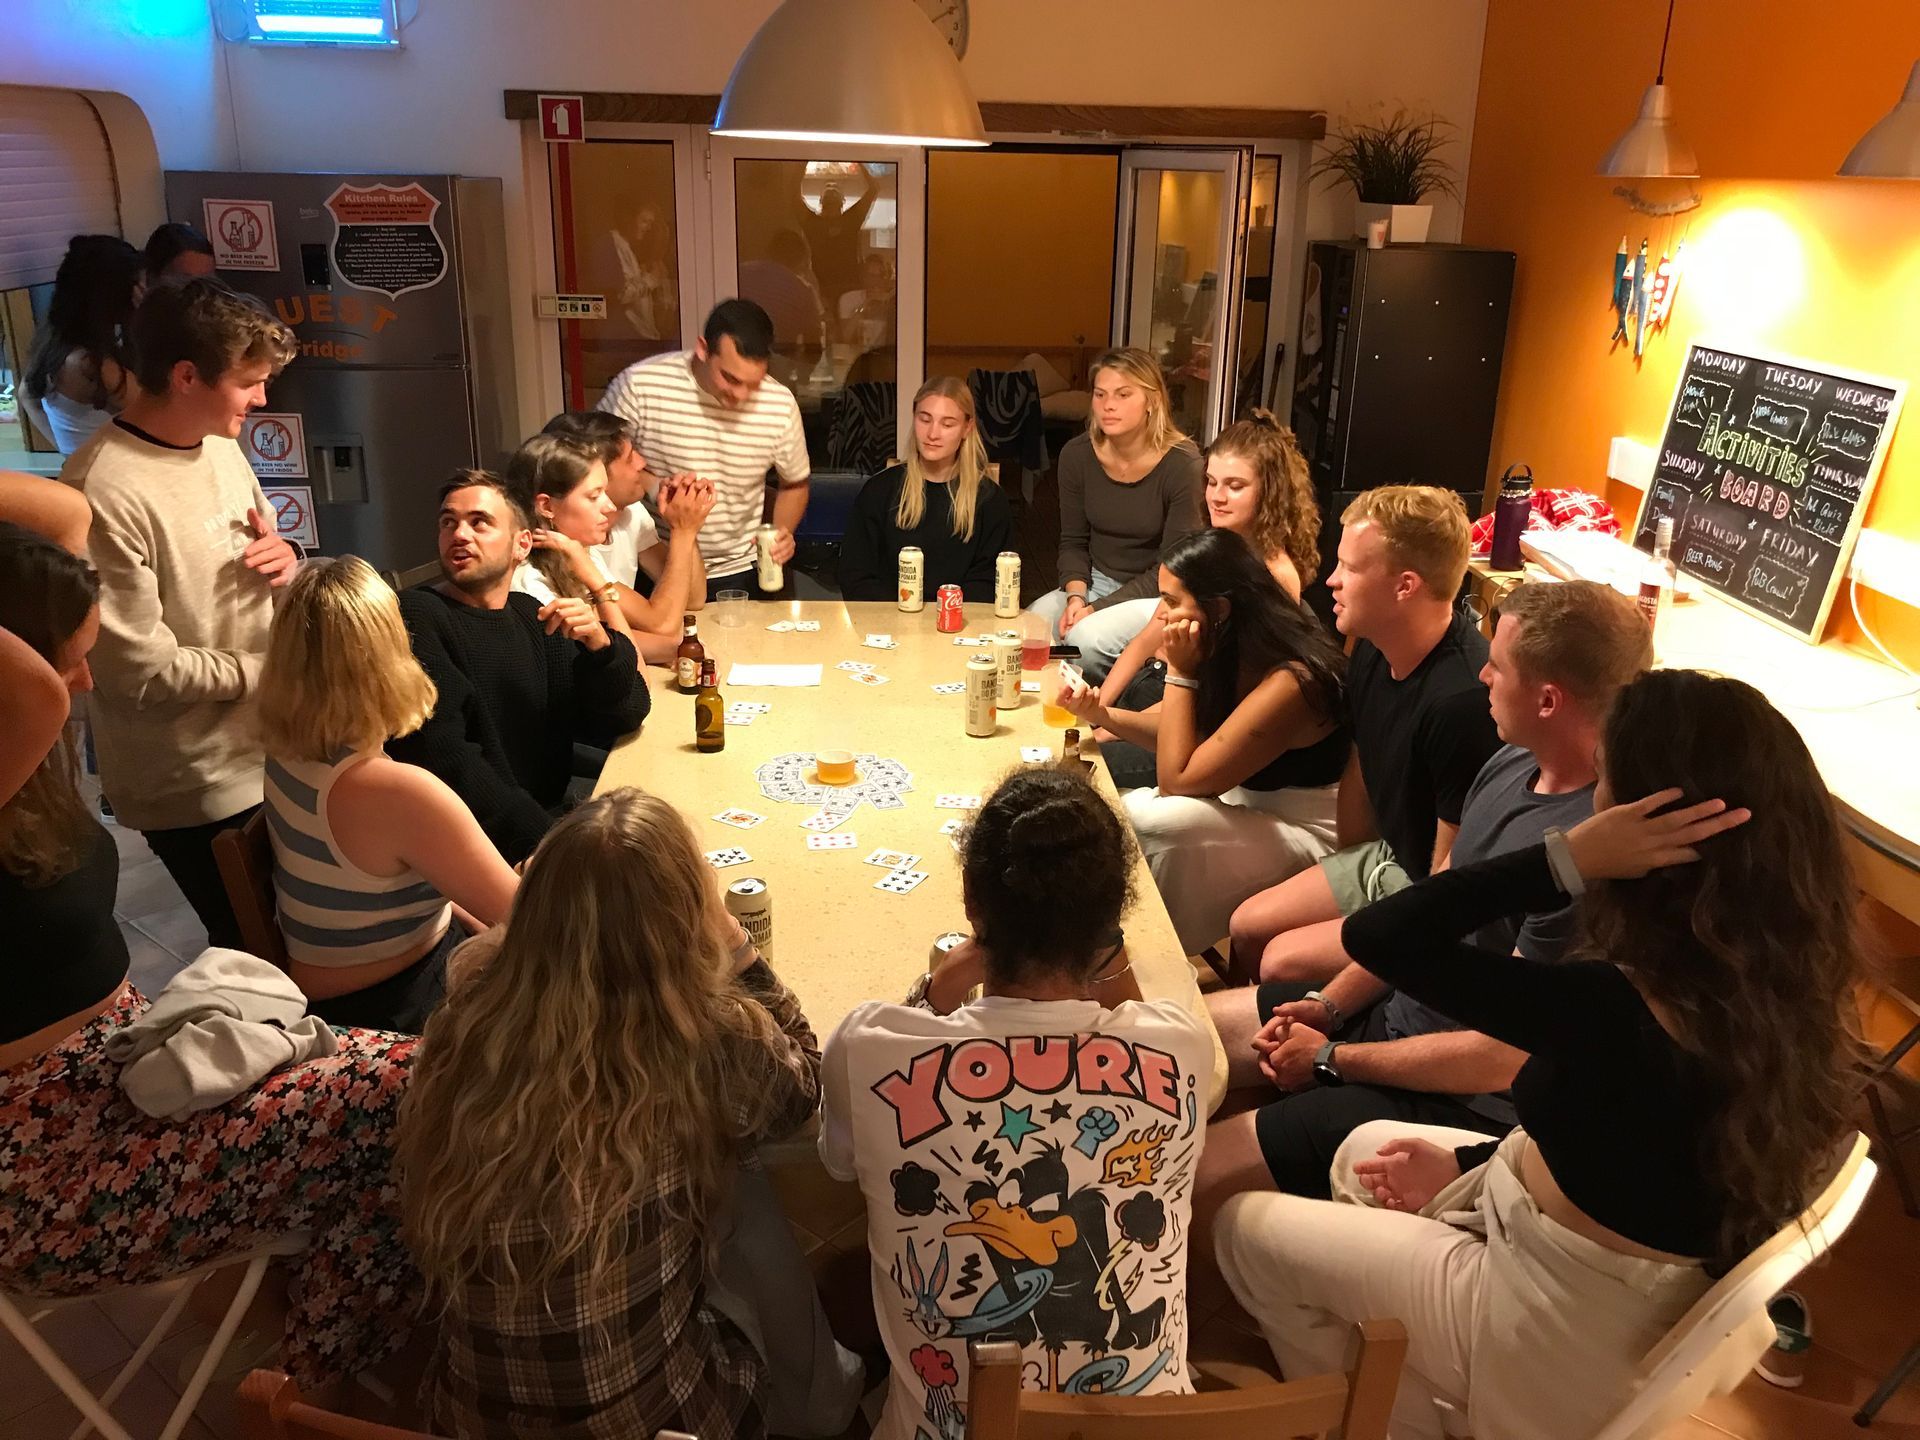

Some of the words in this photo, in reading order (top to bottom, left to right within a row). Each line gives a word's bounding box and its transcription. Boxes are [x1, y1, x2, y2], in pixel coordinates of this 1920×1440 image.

[344, 194, 386, 203] Kitchen
[389, 194, 418, 203] Rules
[274, 294, 398, 333] UEST
[1693, 349, 1746, 374] MONDAY
[1765, 367, 1822, 395] TUESDAY
[1835, 386, 1889, 412] WEDNESD
[1661, 450, 1705, 480] SUNDAY
[1813, 463, 1866, 490] THURSDA
[1720, 469, 1790, 519] BOARD
[1820, 502, 1842, 522] Quiz
[1690, 514, 1746, 551] SATURDAY
[1686, 548, 1703, 565] BEER
[871, 1032, 1181, 1149] YOU'RE
